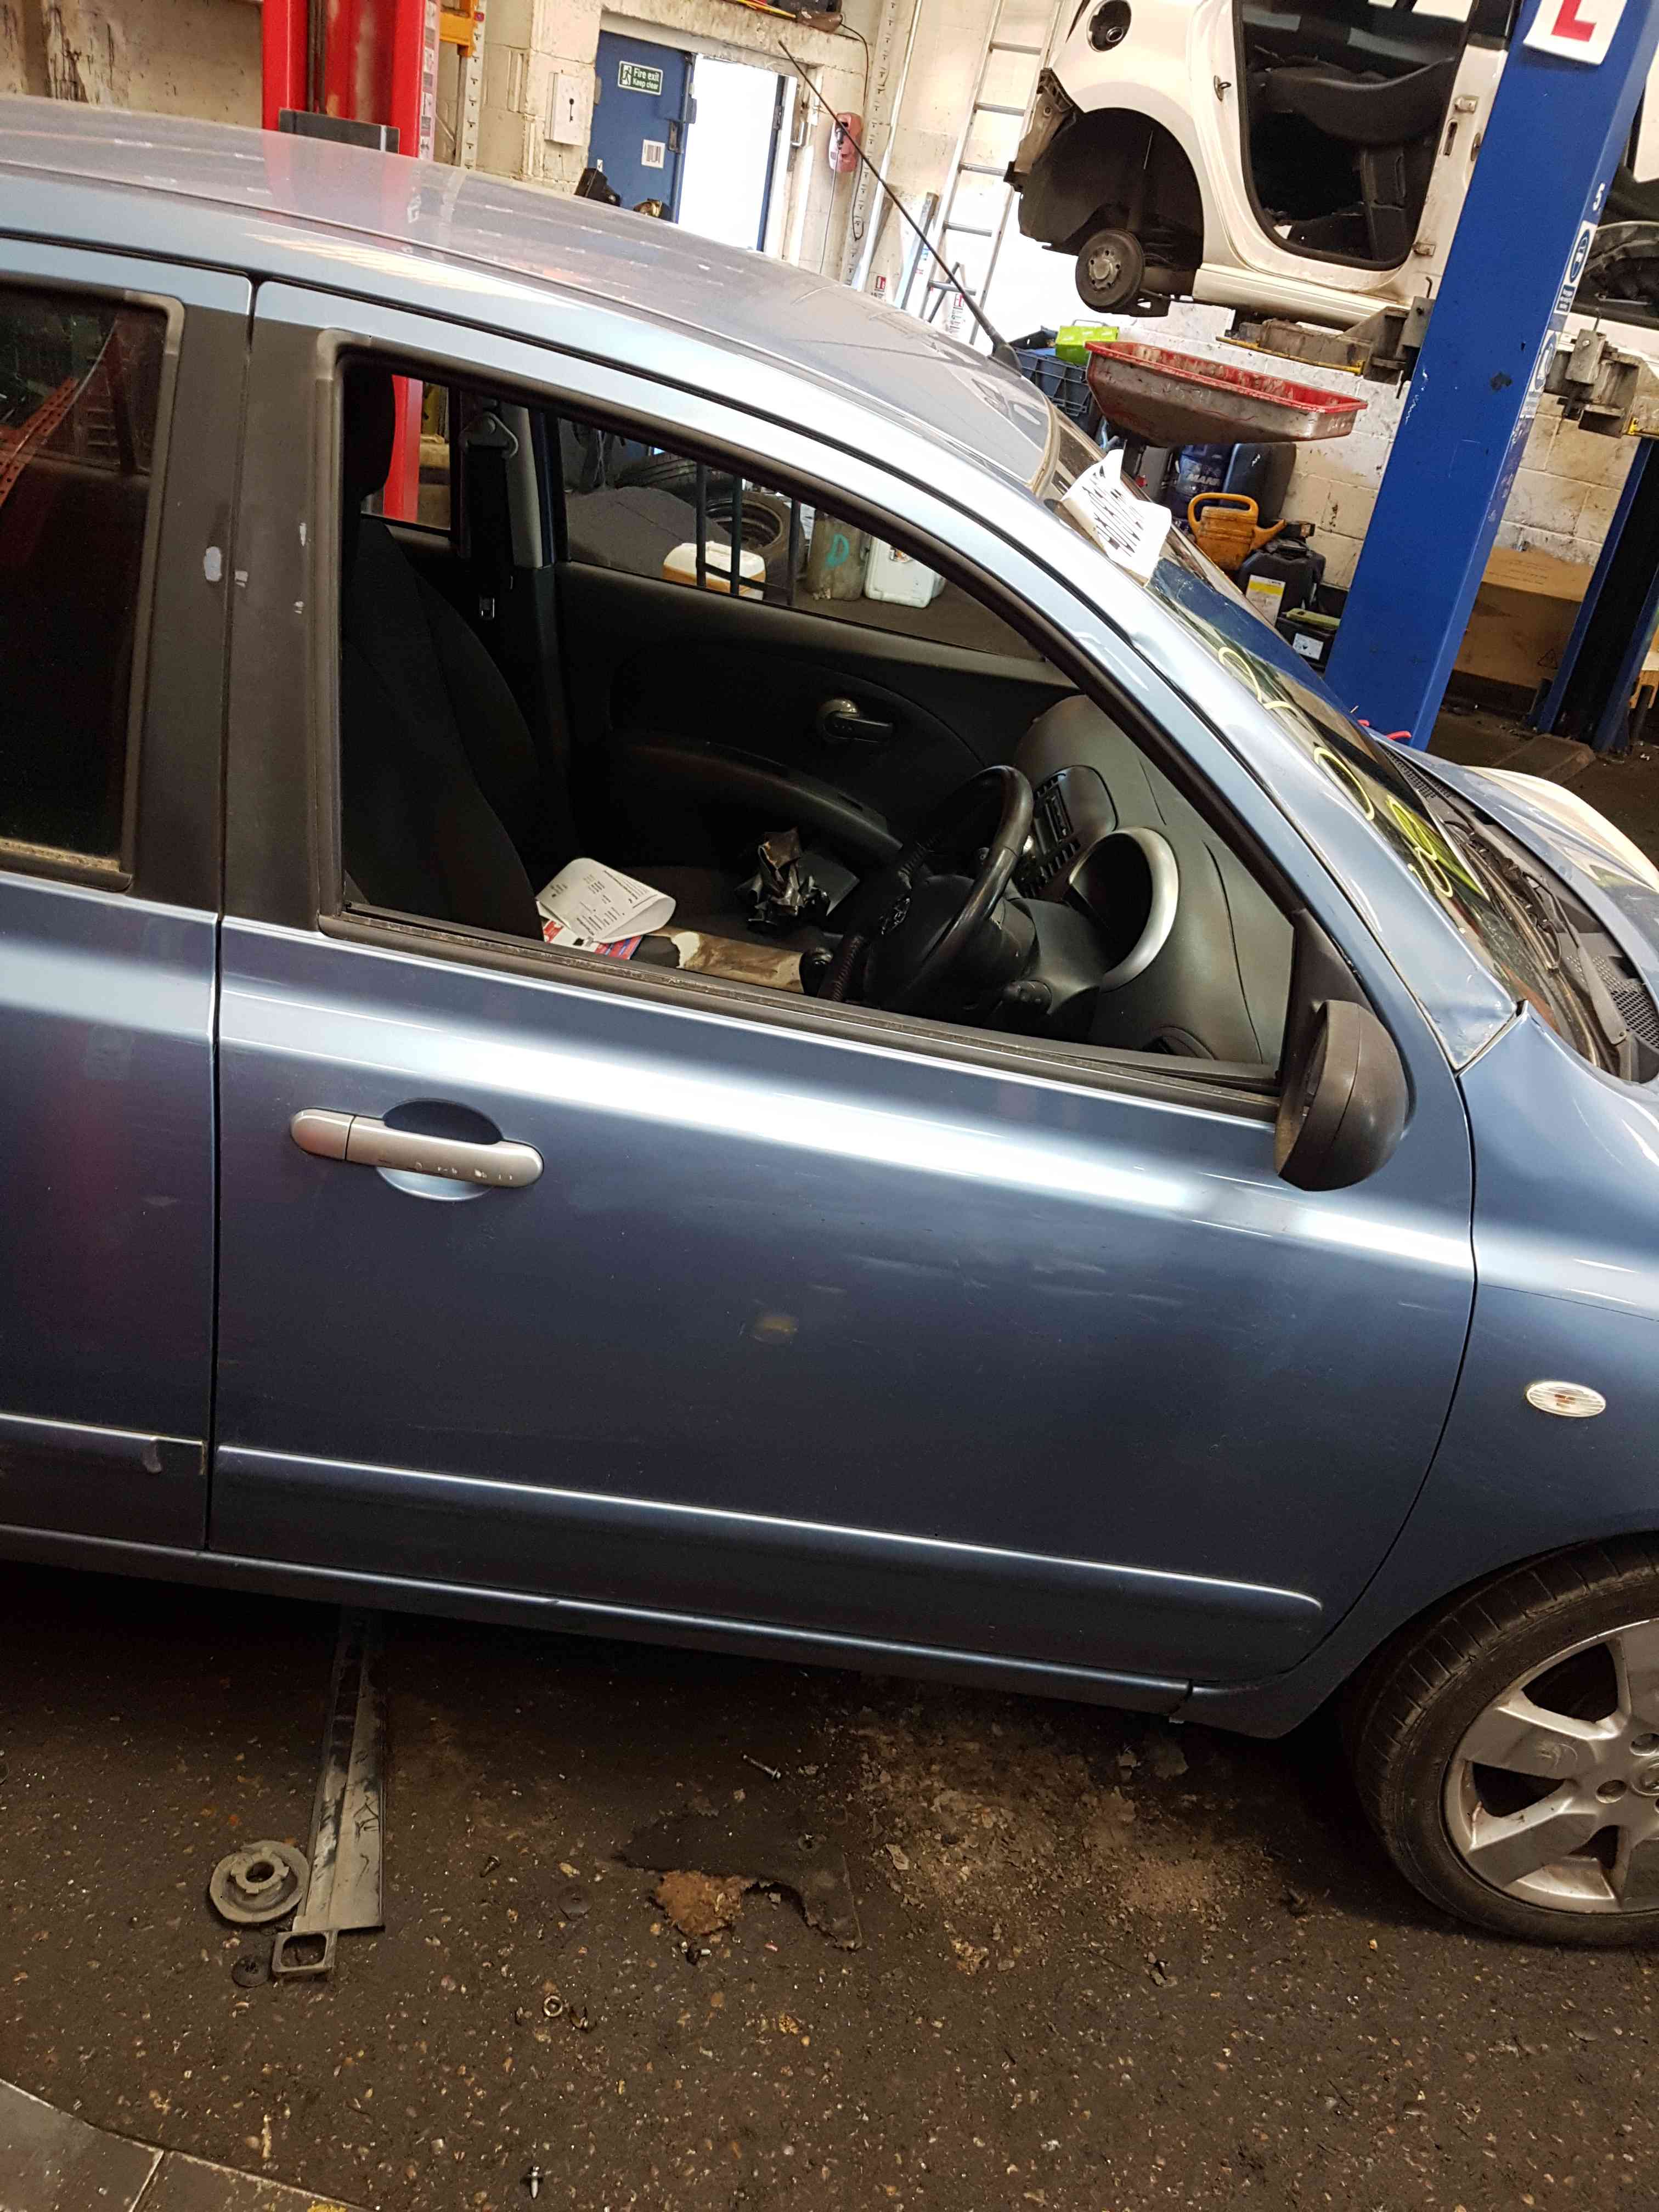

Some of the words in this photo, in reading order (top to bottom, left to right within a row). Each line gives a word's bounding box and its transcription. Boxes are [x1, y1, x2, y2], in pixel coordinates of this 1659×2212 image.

[1551, 0, 1597, 42] L
[633, 77, 646, 88] Keep
[646, 81, 659, 90] clear
[634, 67, 646, 79] Fire
[647, 72, 659, 82] exit
[825, 533, 850, 569] D
